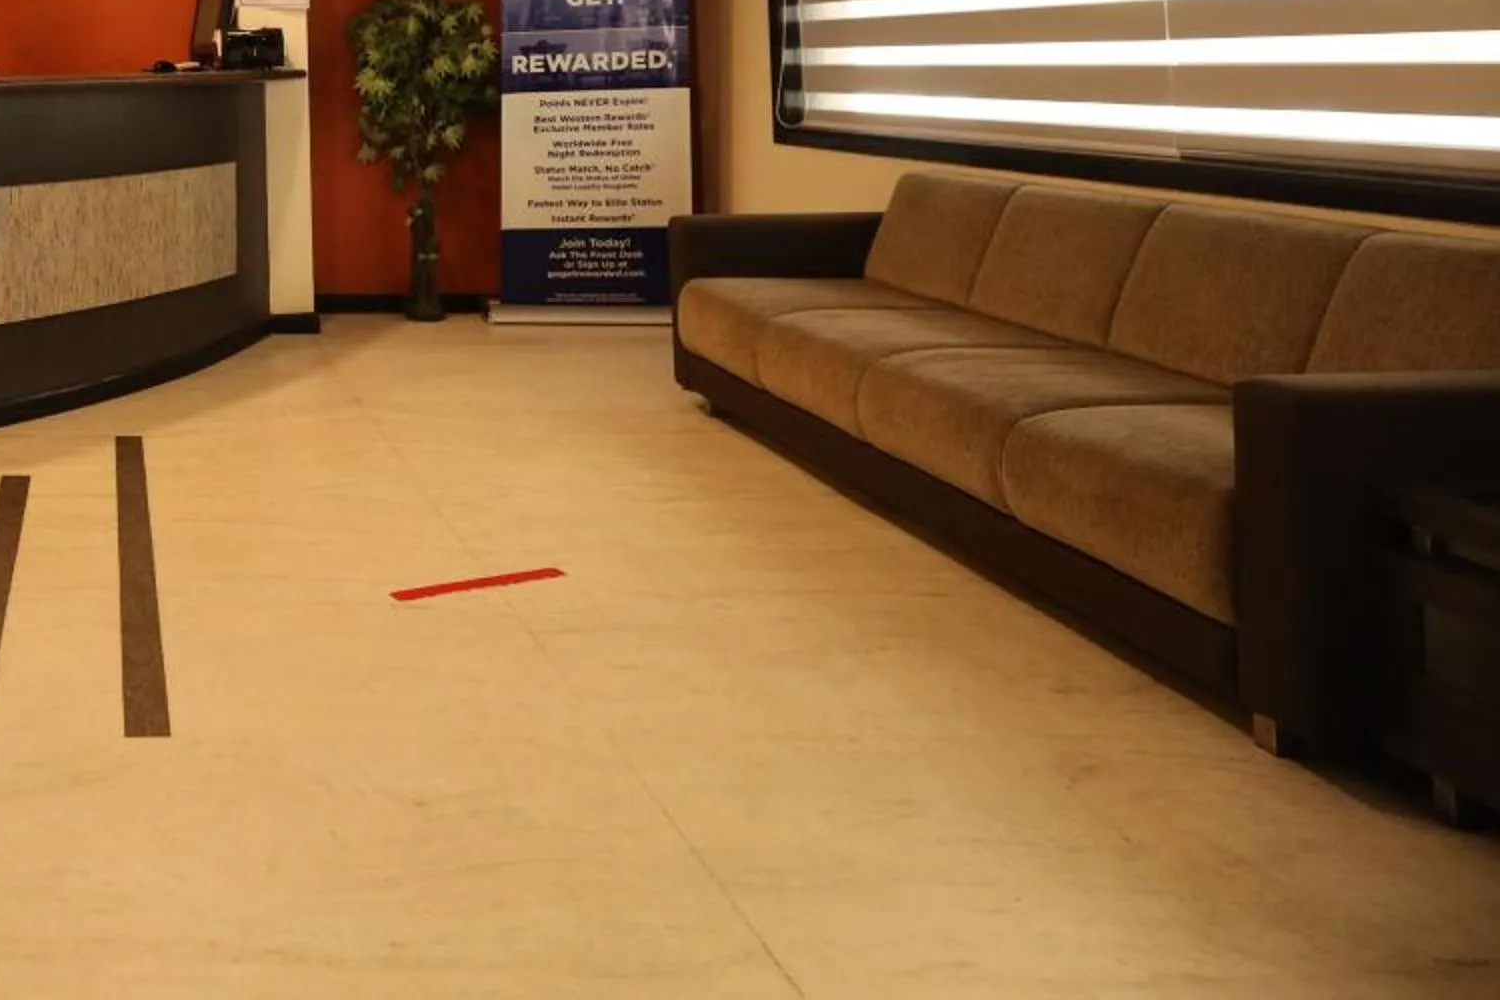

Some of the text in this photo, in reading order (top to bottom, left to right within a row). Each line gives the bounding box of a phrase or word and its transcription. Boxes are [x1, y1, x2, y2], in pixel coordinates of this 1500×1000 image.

[511, 50, 674, 74] REWARDED.
[573, 98, 609, 107] NEVER
[534, 115, 556, 123] Best
[560, 114, 601, 122] Western
[533, 125, 580, 133] Exclusive
[627, 122, 654, 131] Rates
[552, 139, 632, 148] Worldwide Free
[548, 149, 641, 159] Night Redemption
[534, 166, 566, 174] Status
[606, 164, 620, 173] No
[527, 197, 663, 208] Fastest Way to Elite Status
[551, 215, 586, 223] Instant
[559, 236, 631, 249] Join Today!
[549, 251, 567, 259] Ask
[569, 251, 588, 259] The
[619, 250, 644, 259] Desk
[577, 260, 599, 270] Sign
[601, 260, 616, 269] Up
